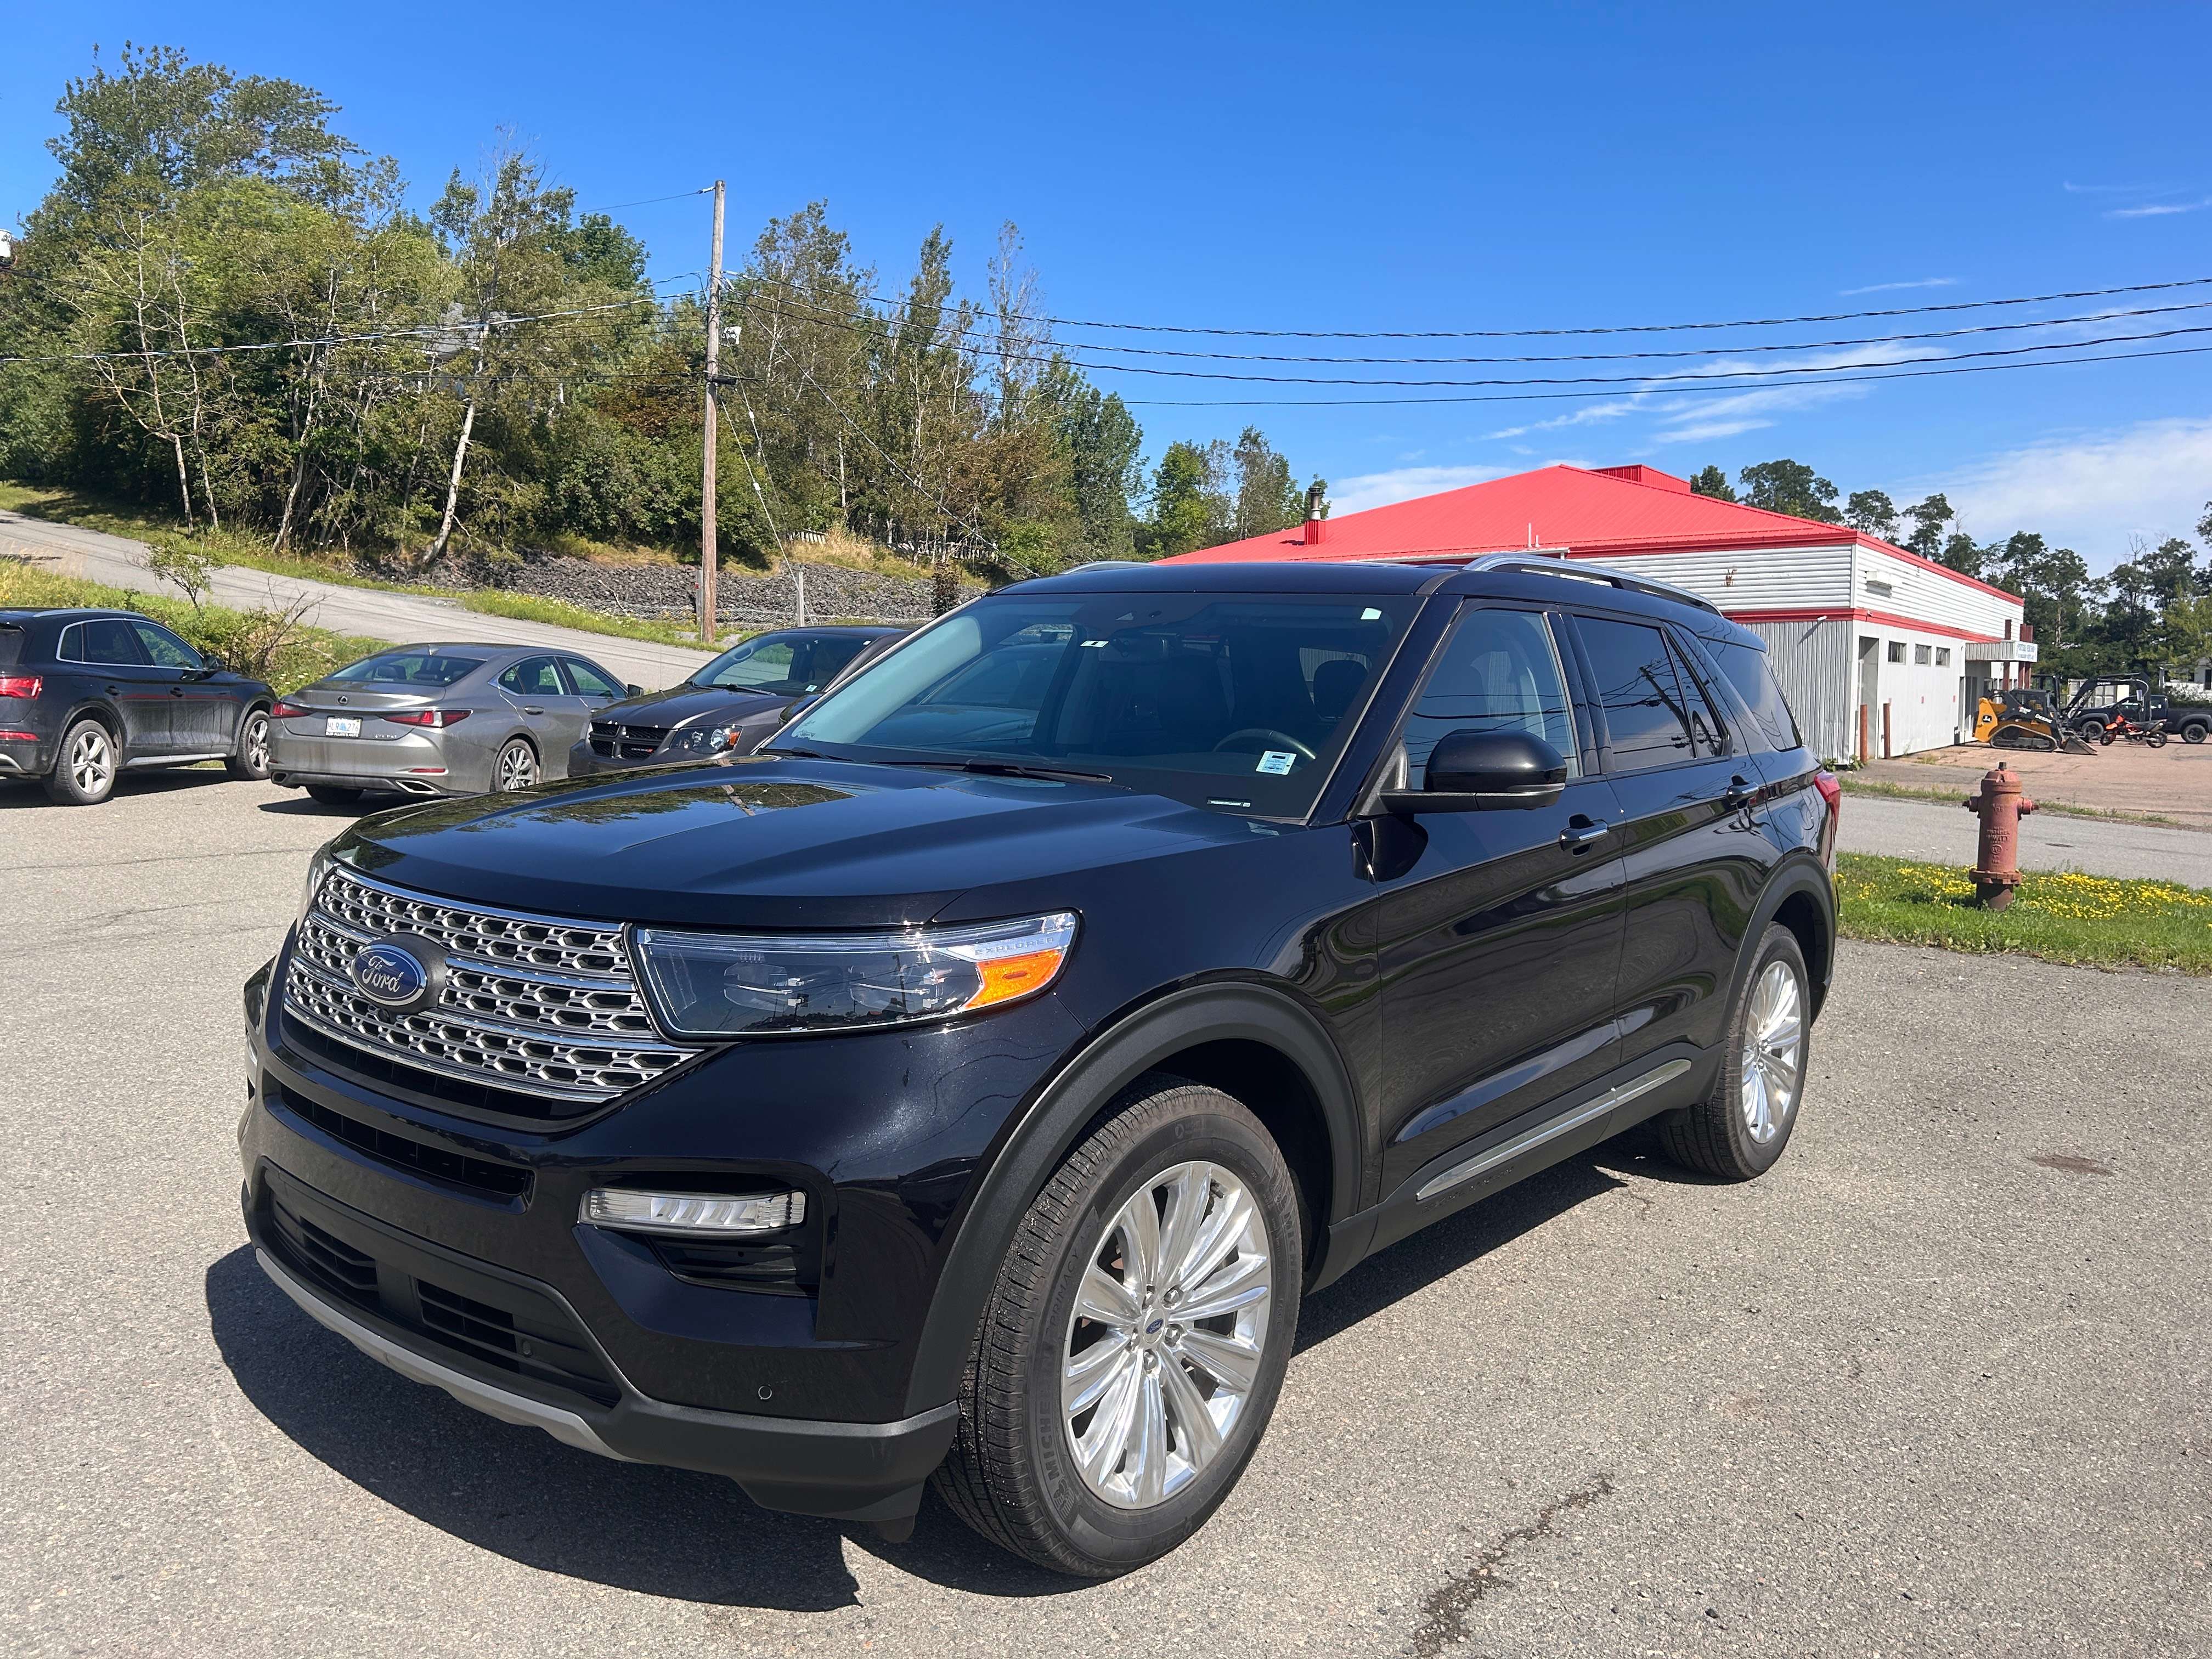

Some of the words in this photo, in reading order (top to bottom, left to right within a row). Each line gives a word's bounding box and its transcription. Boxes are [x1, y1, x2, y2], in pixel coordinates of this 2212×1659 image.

[347, 723, 359, 732] 276
[975, 937, 1053, 955] EXPLORER
[362, 956, 404, 992] Ford
